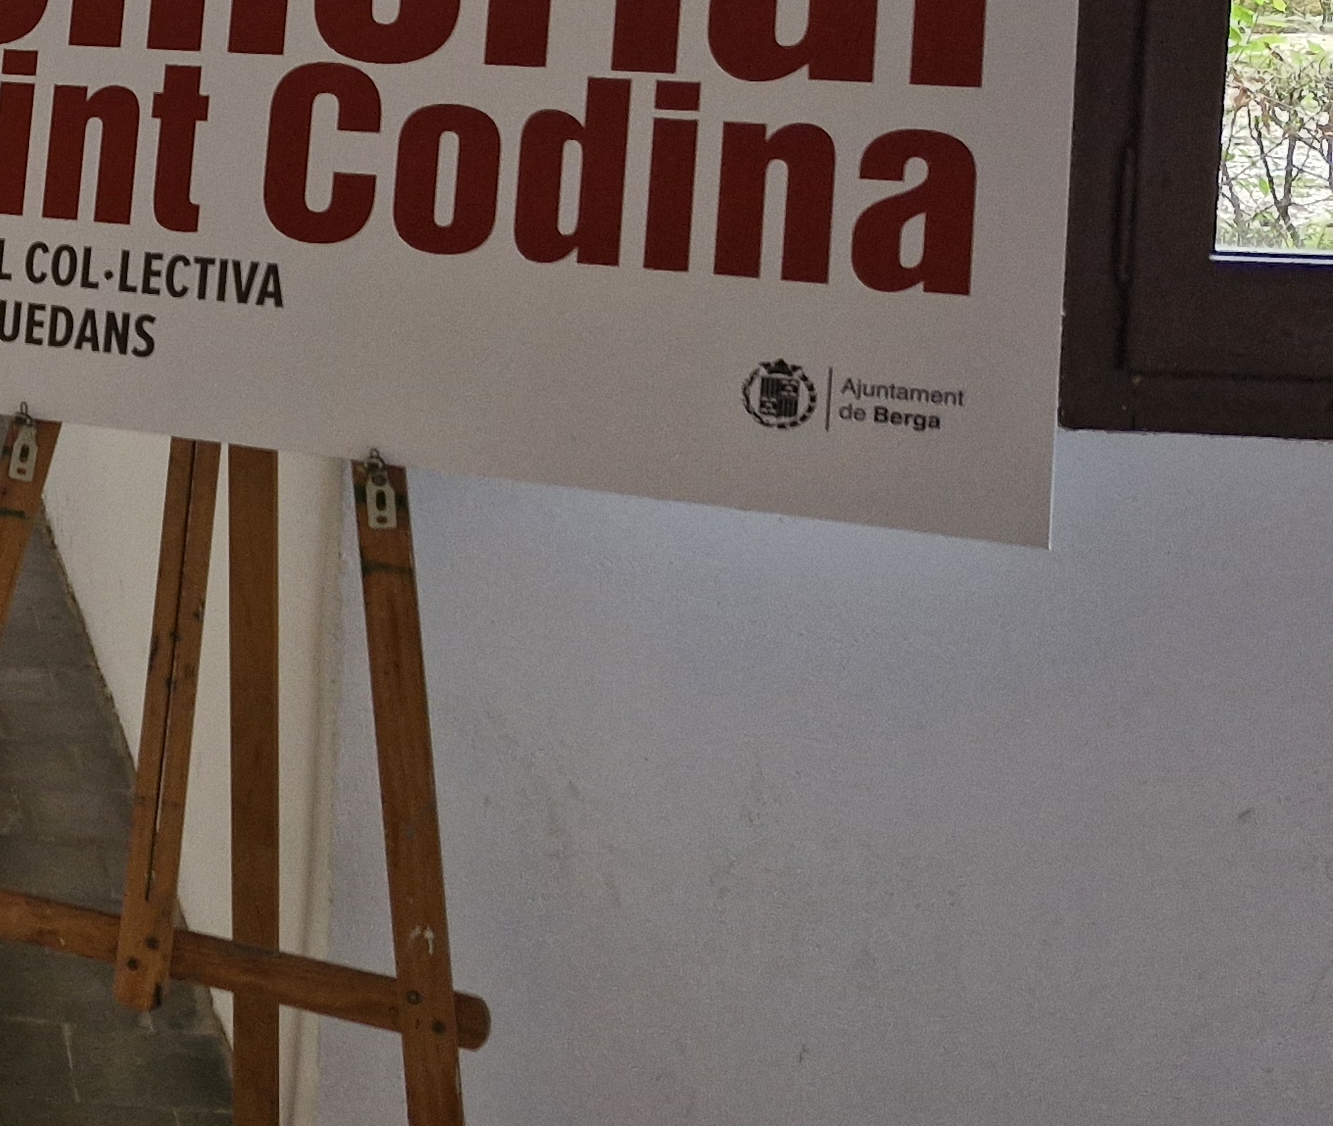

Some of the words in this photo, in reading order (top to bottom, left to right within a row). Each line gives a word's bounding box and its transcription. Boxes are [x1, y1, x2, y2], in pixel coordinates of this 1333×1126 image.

[263, 62, 979, 296] Codina
[25, 241, 284, 309] COL·LECTIVA
[840, 377, 965, 407] Ajuntament
[838, 403, 867, 422] de
[873, 405, 942, 432] Berga
